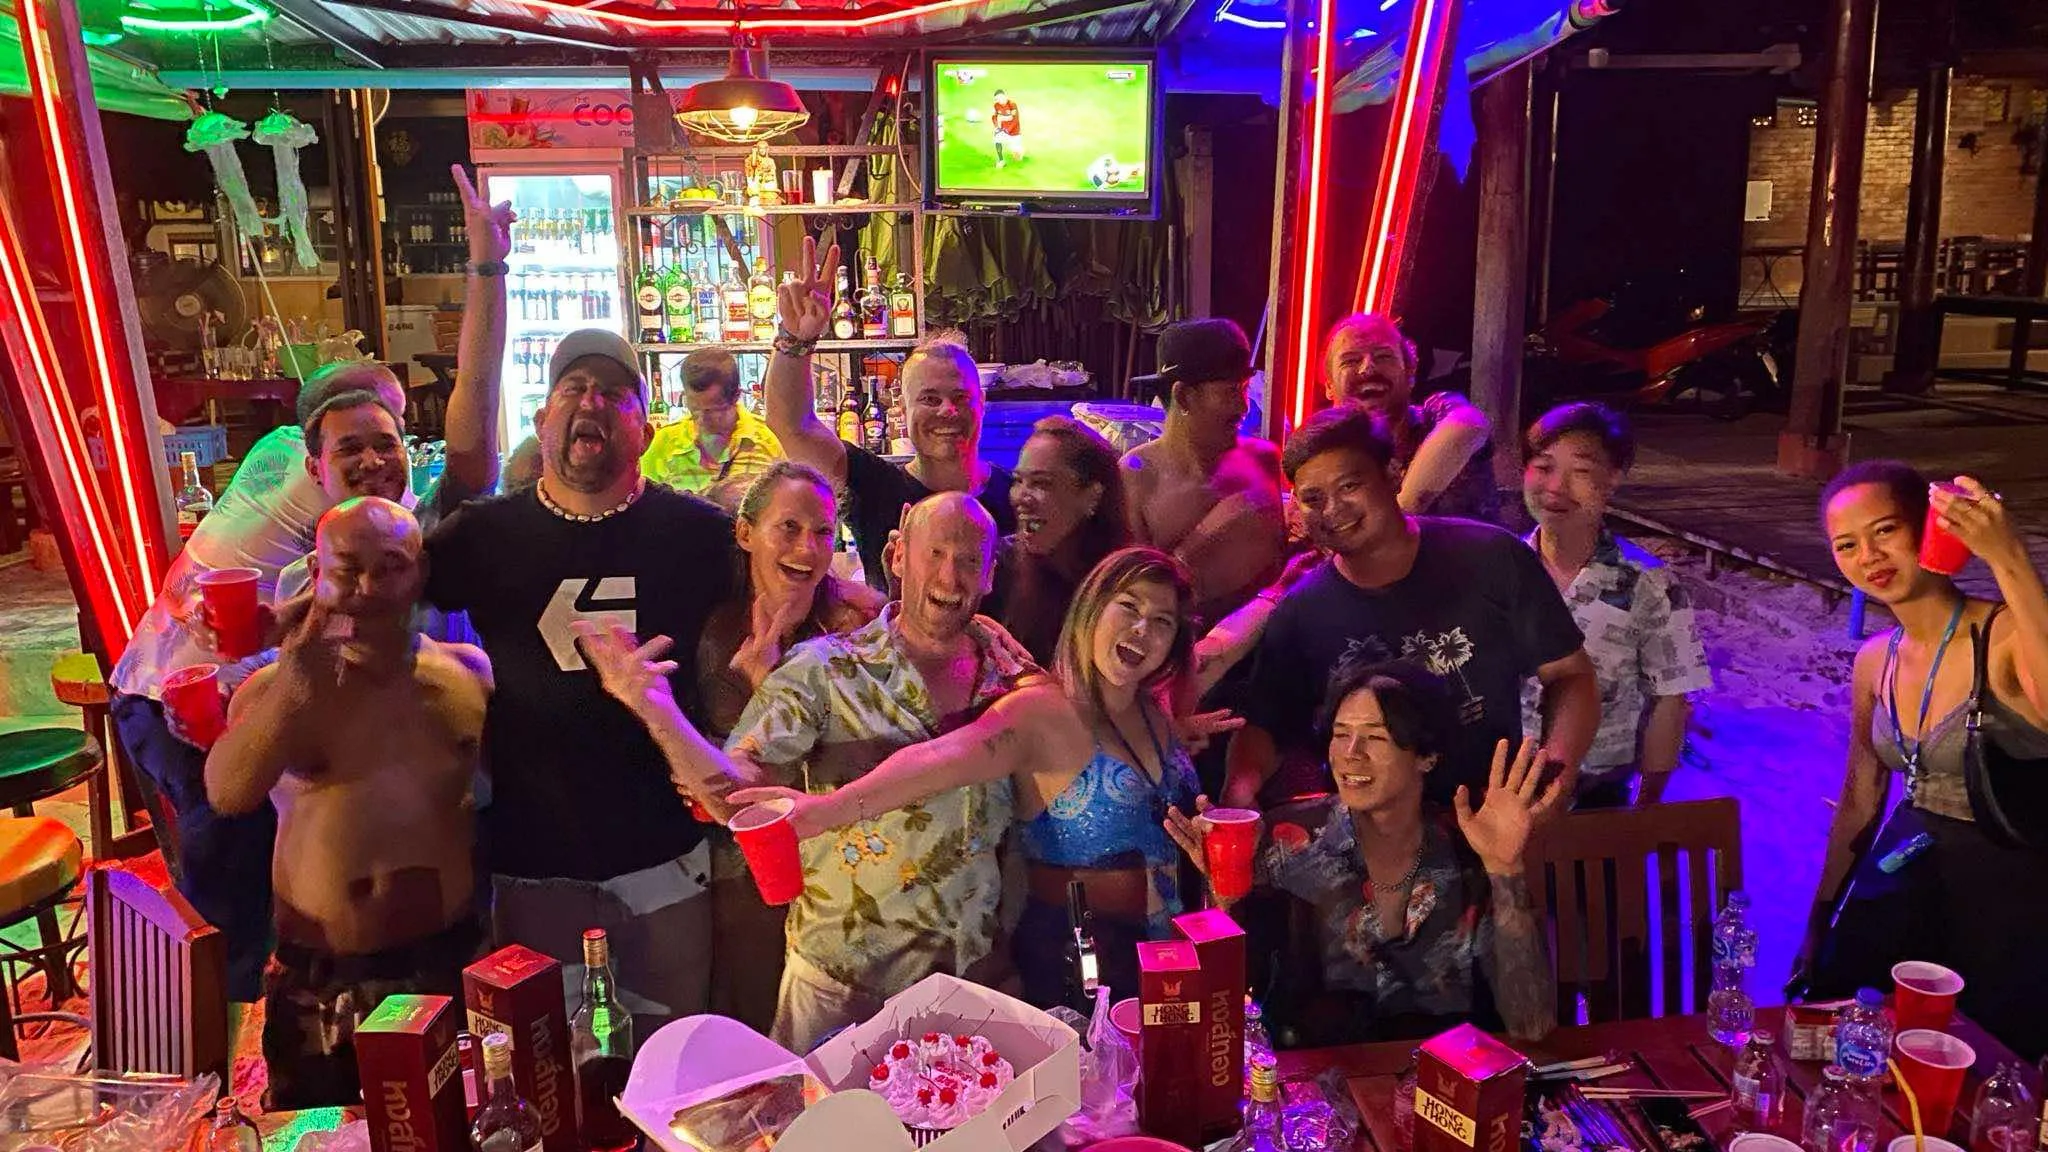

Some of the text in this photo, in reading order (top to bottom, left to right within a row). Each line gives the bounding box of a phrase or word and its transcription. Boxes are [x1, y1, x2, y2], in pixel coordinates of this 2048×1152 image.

[1151, 1012, 1194, 1023] THONG
[1154, 1004, 1190, 1016] HONG
[1422, 1103, 1469, 1140] THONG
[1426, 1096, 1464, 1127] HONG
